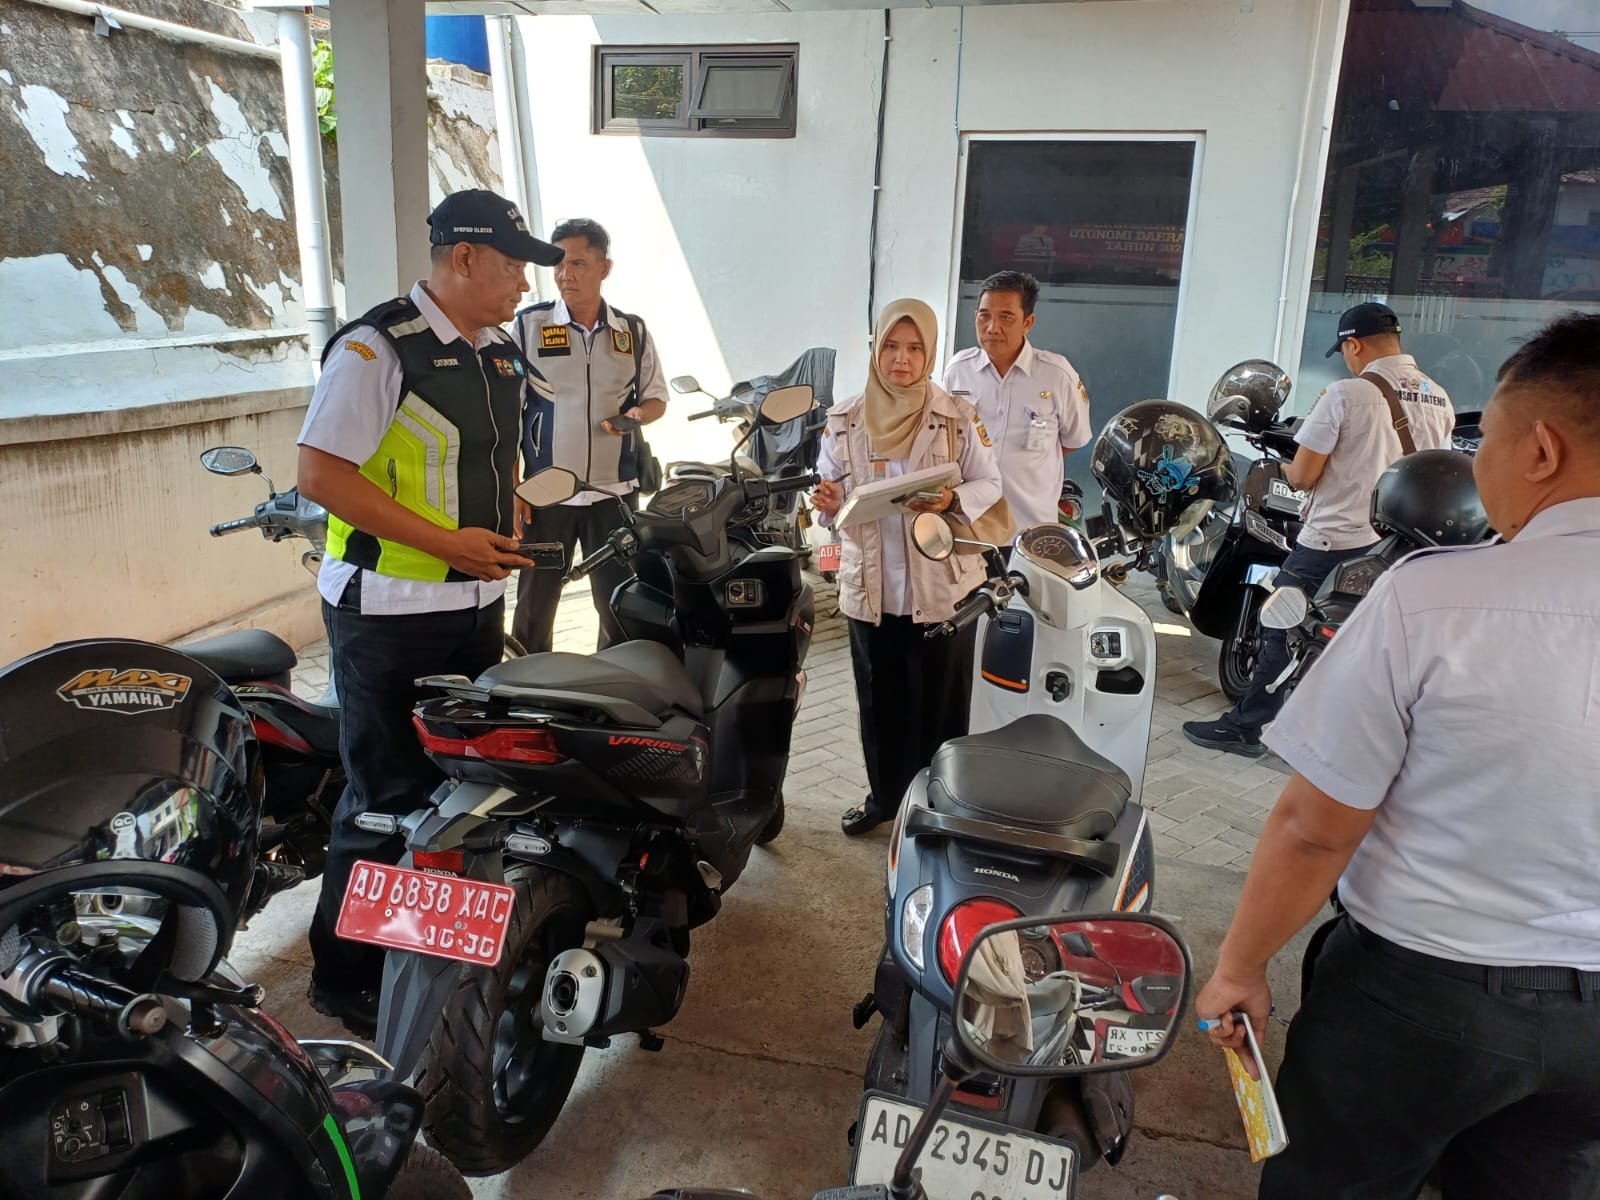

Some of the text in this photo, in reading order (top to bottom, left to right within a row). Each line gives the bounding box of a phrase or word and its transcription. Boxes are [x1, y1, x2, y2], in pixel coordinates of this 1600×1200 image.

[1136, 231, 1184, 243] DAERA
[1395, 390, 1447, 408] MSAT JATENG
[1274, 484, 1288, 497] AD
[820, 546, 833, 558] AD
[87, 692, 164, 707] YAMAHA
[608, 735, 671, 749] VARIO
[423, 867, 458, 878] HONDA
[974, 867, 1020, 882] HONDA
[351, 867, 509, 923] AD 6838 XAC
[871, 1109, 1068, 1192] AD 2345 DJ
